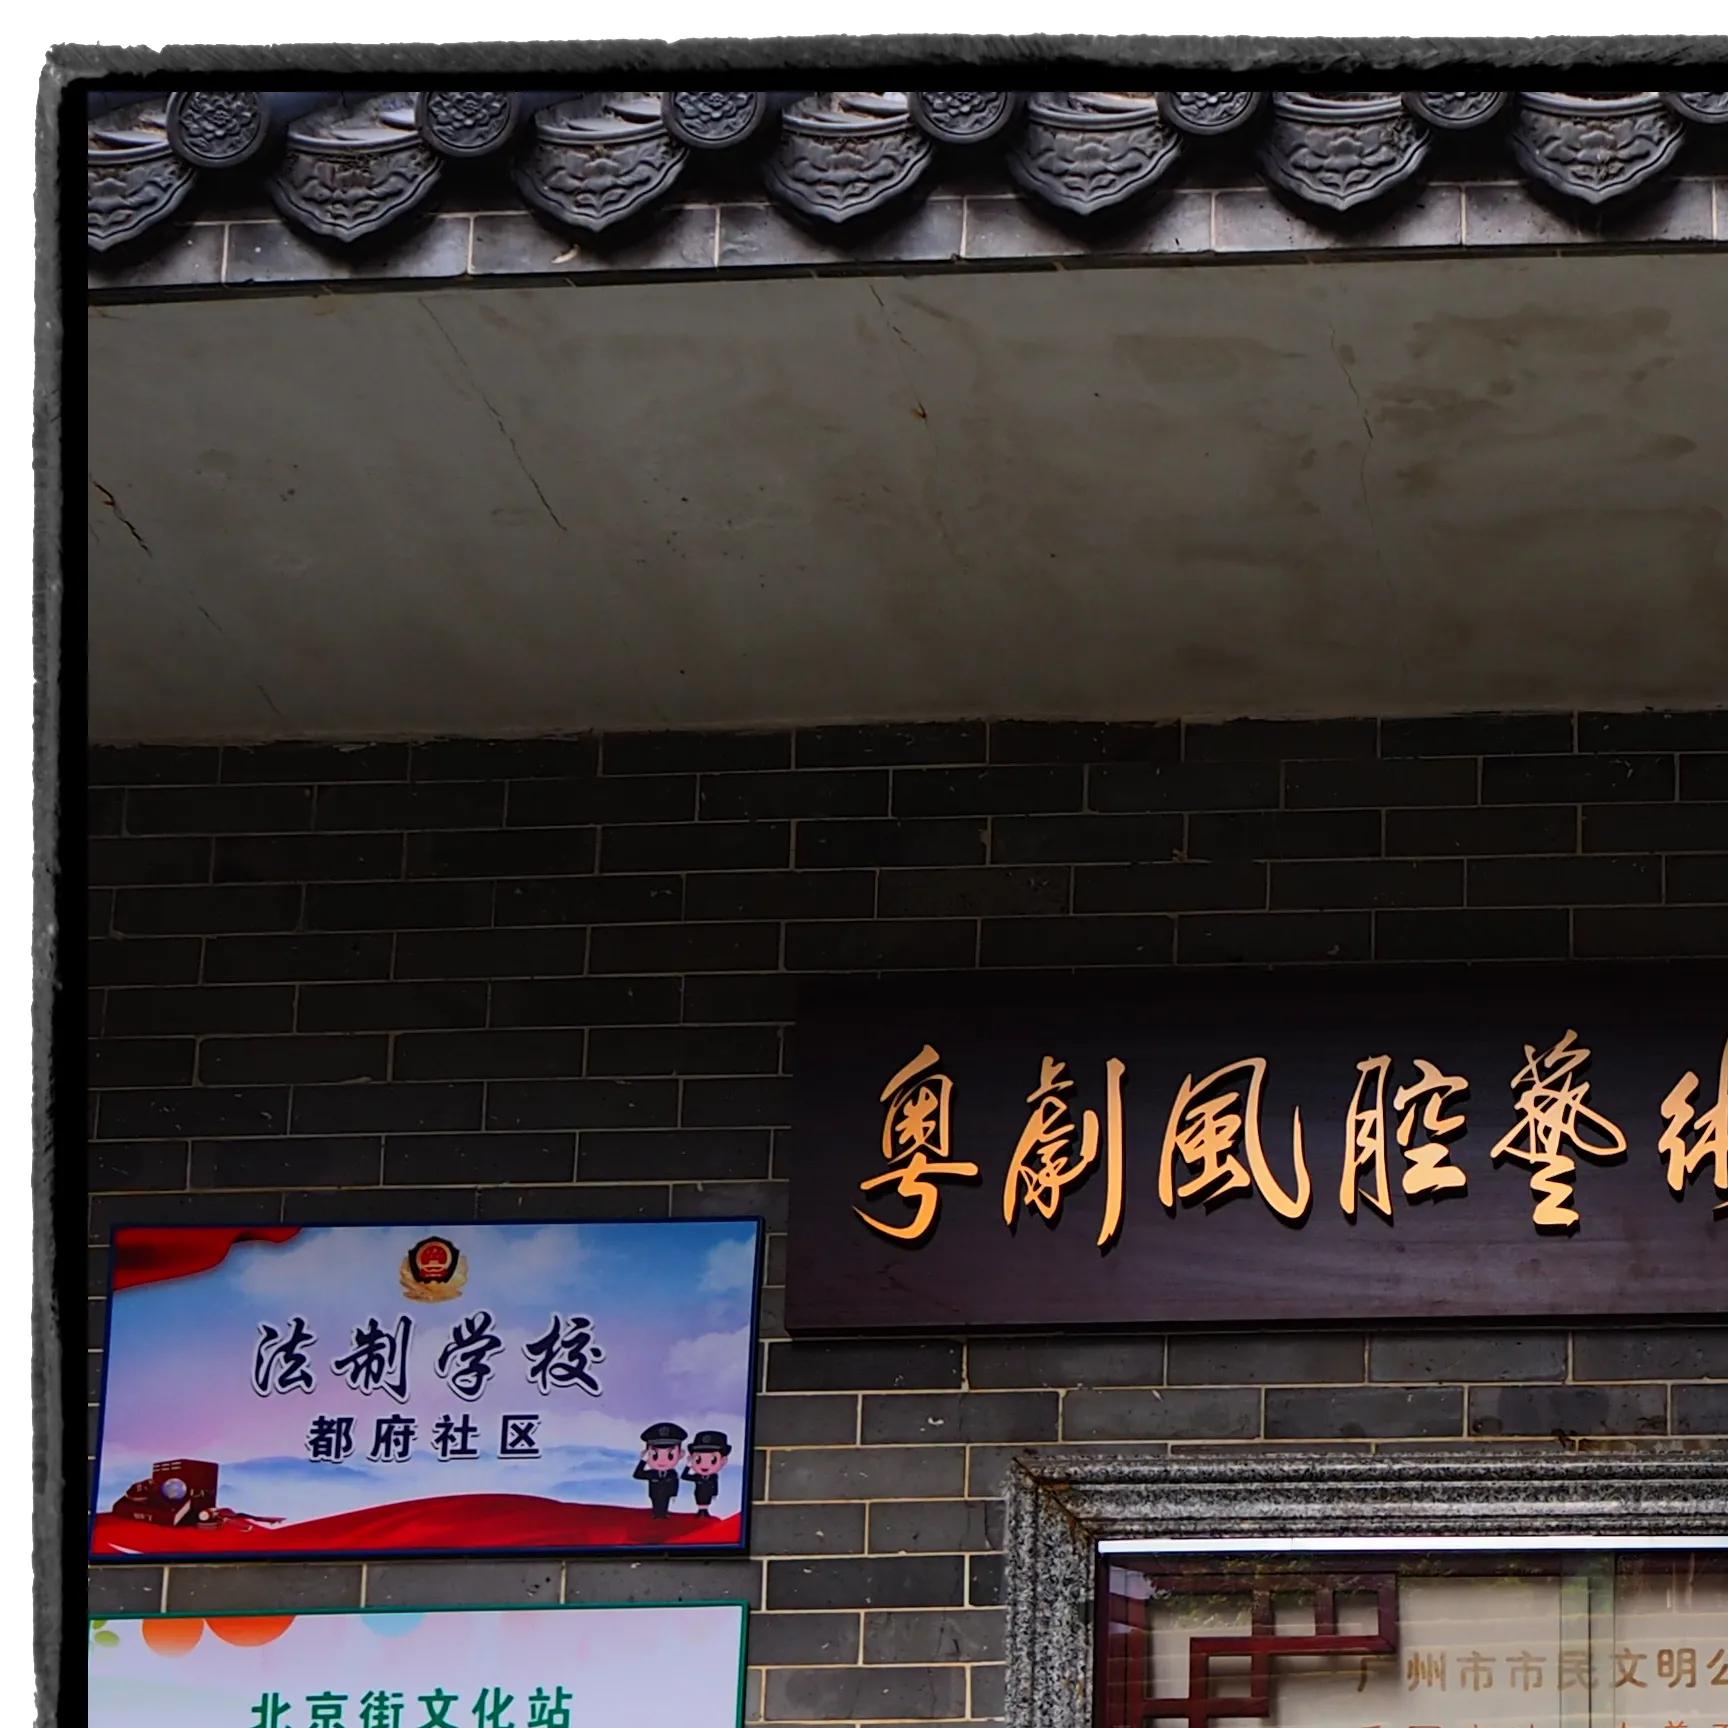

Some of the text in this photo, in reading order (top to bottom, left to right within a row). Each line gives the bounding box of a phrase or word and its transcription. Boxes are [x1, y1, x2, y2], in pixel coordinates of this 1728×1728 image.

[254, 1311, 605, 1399] 法制学校
[307, 1413, 542, 1461] 都府社区
